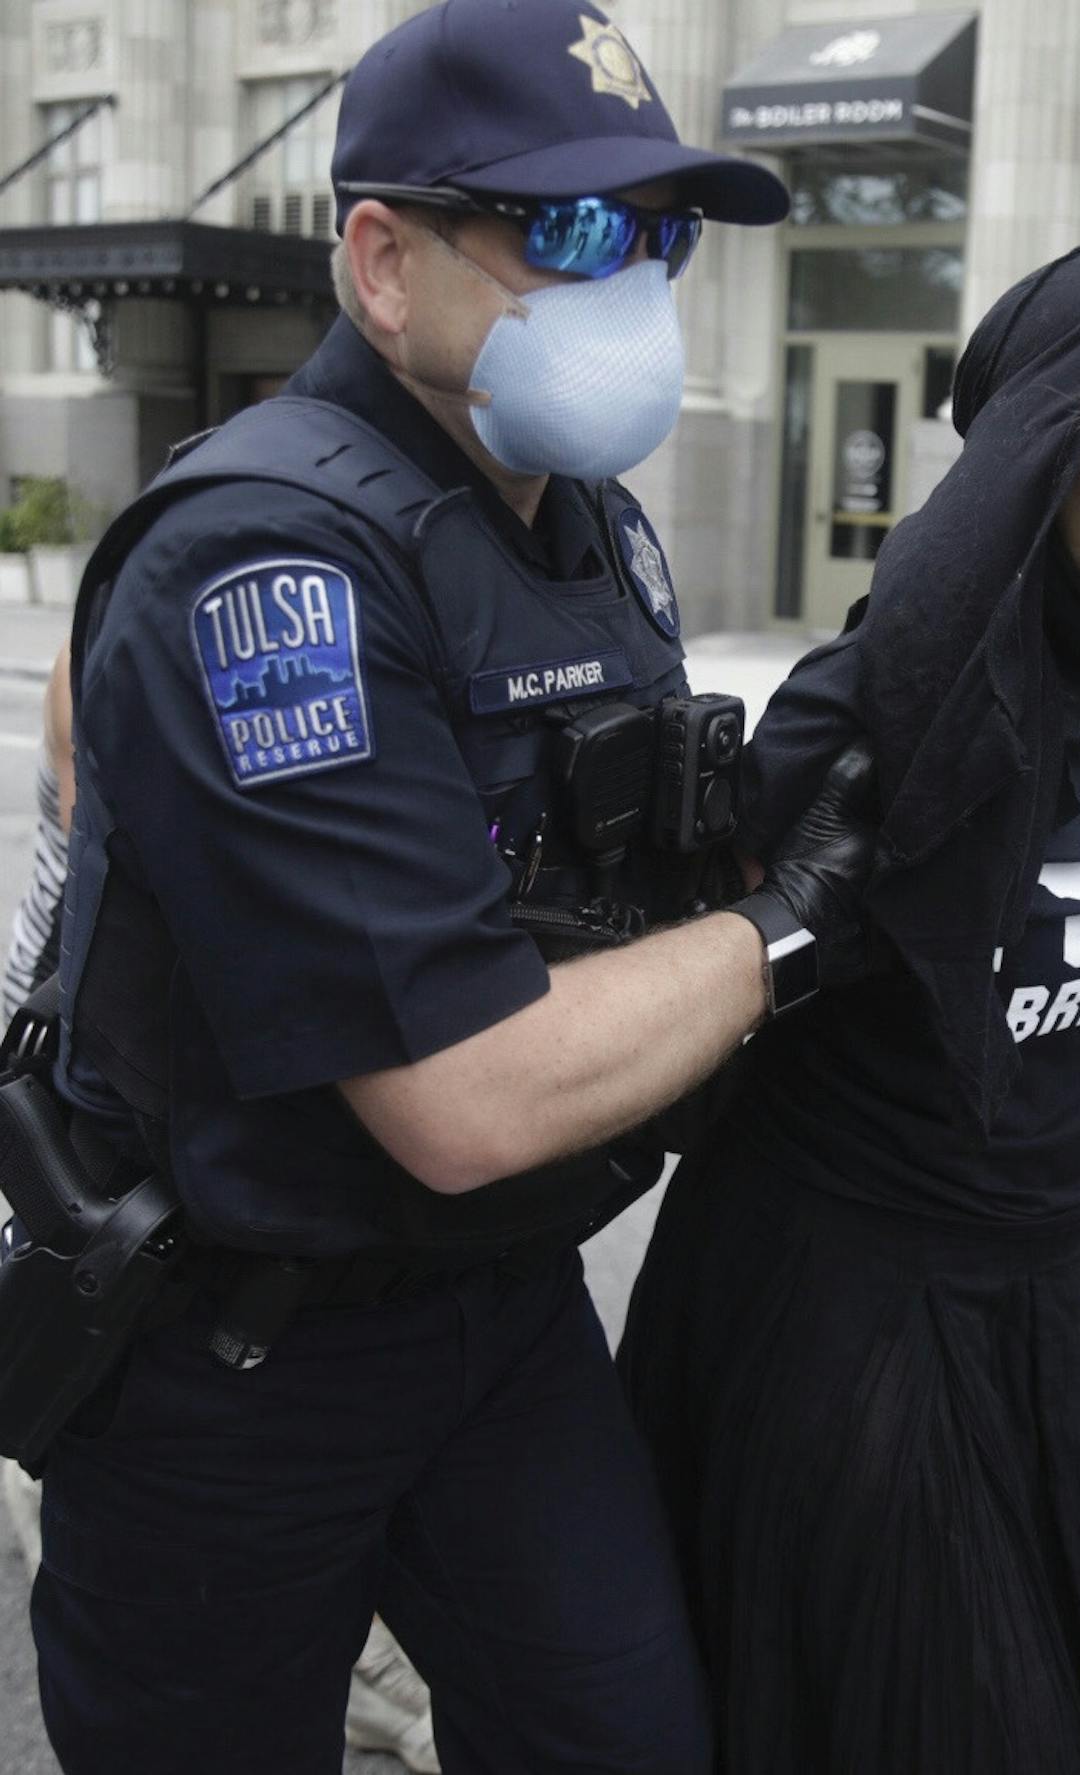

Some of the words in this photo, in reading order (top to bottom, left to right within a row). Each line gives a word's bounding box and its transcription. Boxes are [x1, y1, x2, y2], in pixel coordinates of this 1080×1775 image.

[754, 102, 832, 129] BOILER
[833, 98, 903, 123] ROOM
[203, 574, 335, 669] TULSA
[543, 660, 605, 695] PARKER
[230, 696, 353, 753] POLICE
[238, 731, 359, 775] RESERVE
